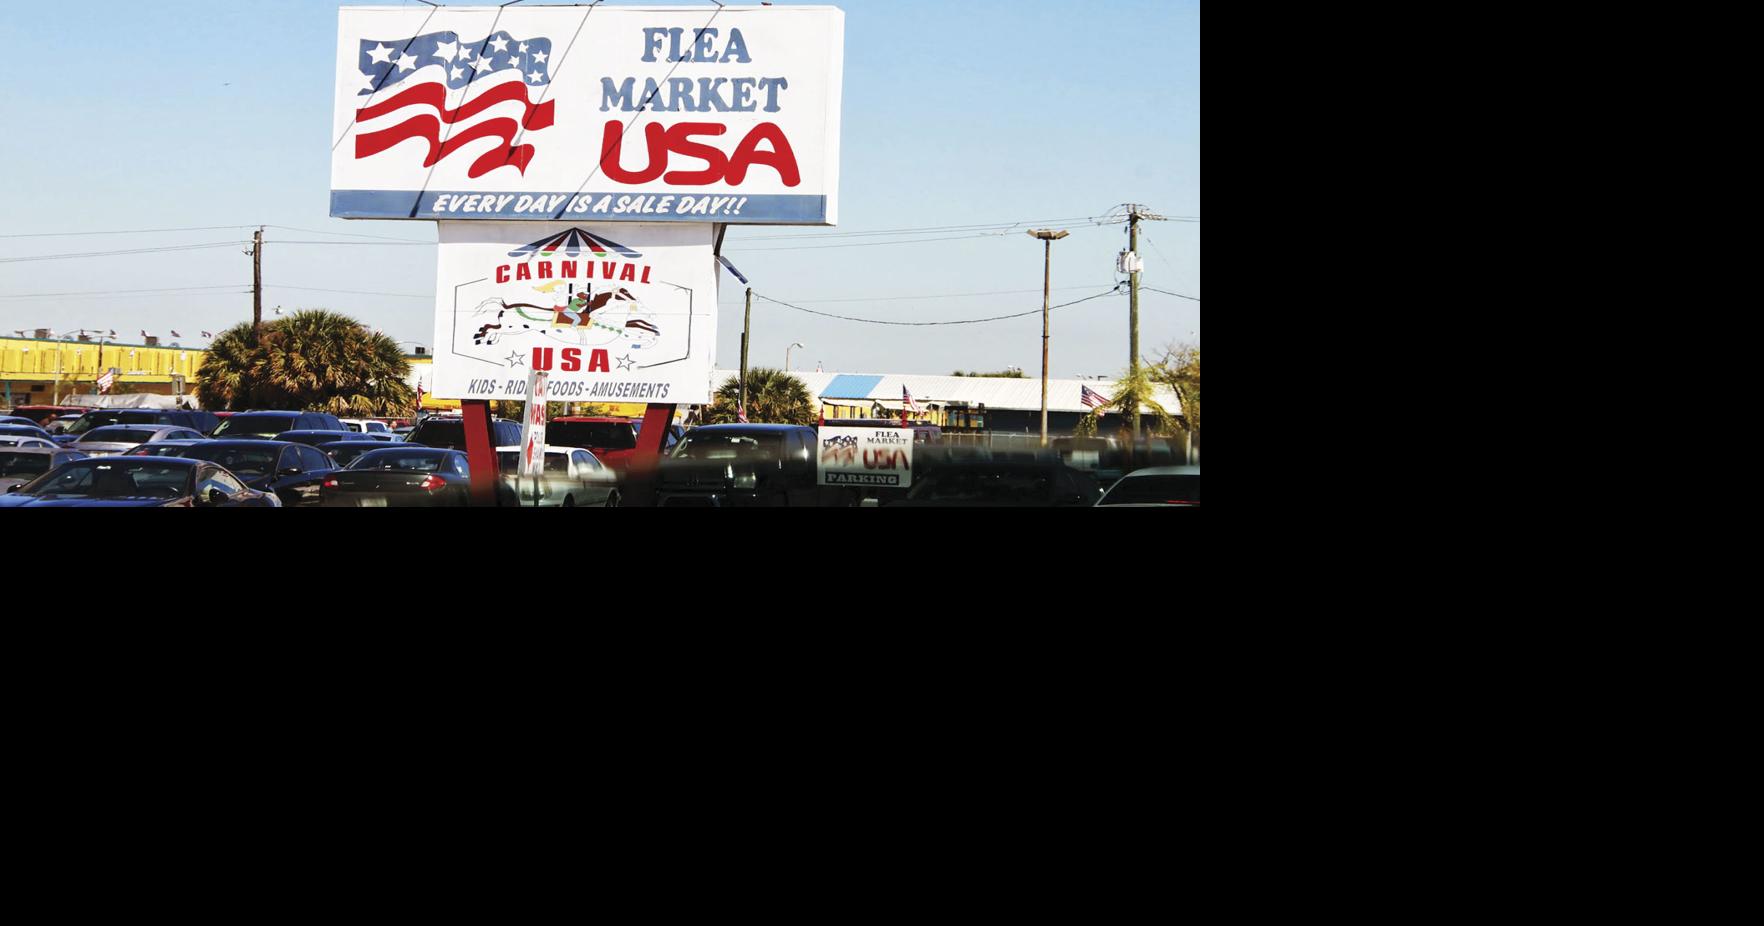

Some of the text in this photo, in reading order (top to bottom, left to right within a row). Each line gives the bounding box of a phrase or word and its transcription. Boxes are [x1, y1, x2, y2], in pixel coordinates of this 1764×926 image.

[641, 27, 752, 64] FLEA
[600, 77, 788, 113] MARKET
[600, 120, 801, 187] USA
[432, 194, 748, 215] EVERY DAY IS A SALE DAY!!
[495, 260, 651, 284] CARNIVAL
[532, 347, 610, 373] USA
[468, 379, 496, 395] KIDS
[505, 380, 528, 395] RID
[589, 382, 670, 399] AMUSEMENTS
[867, 437, 907, 445] MARKET
[863, 448, 909, 471] USA
[827, 473, 897, 484] PARKING
